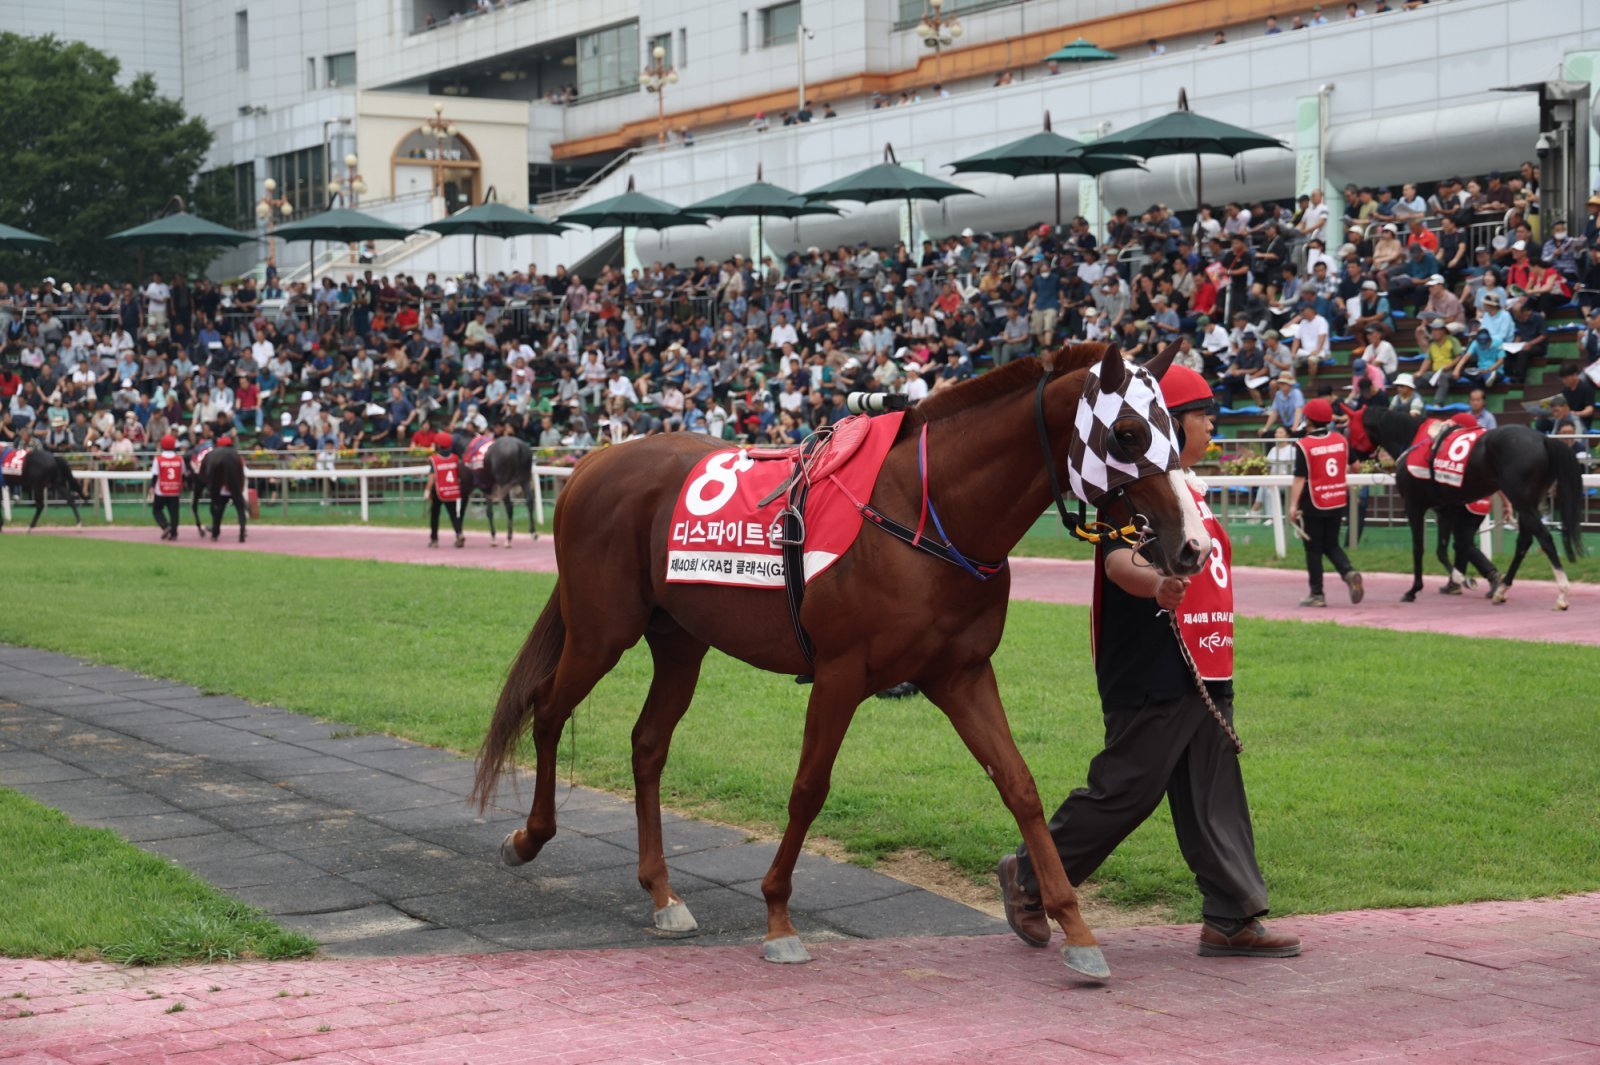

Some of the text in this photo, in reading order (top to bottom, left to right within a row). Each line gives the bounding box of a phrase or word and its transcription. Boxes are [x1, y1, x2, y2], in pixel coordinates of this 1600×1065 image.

[1448, 432, 1476, 462] 6
[167, 468, 176, 480] 3
[446, 470, 454, 482] 4
[1325, 457, 1338, 477] 6
[685, 449, 755, 516] 8
[671, 558, 698, 572] 제40회
[700, 558, 733, 574] KRA컵
[1210, 537, 1228, 588] 8
